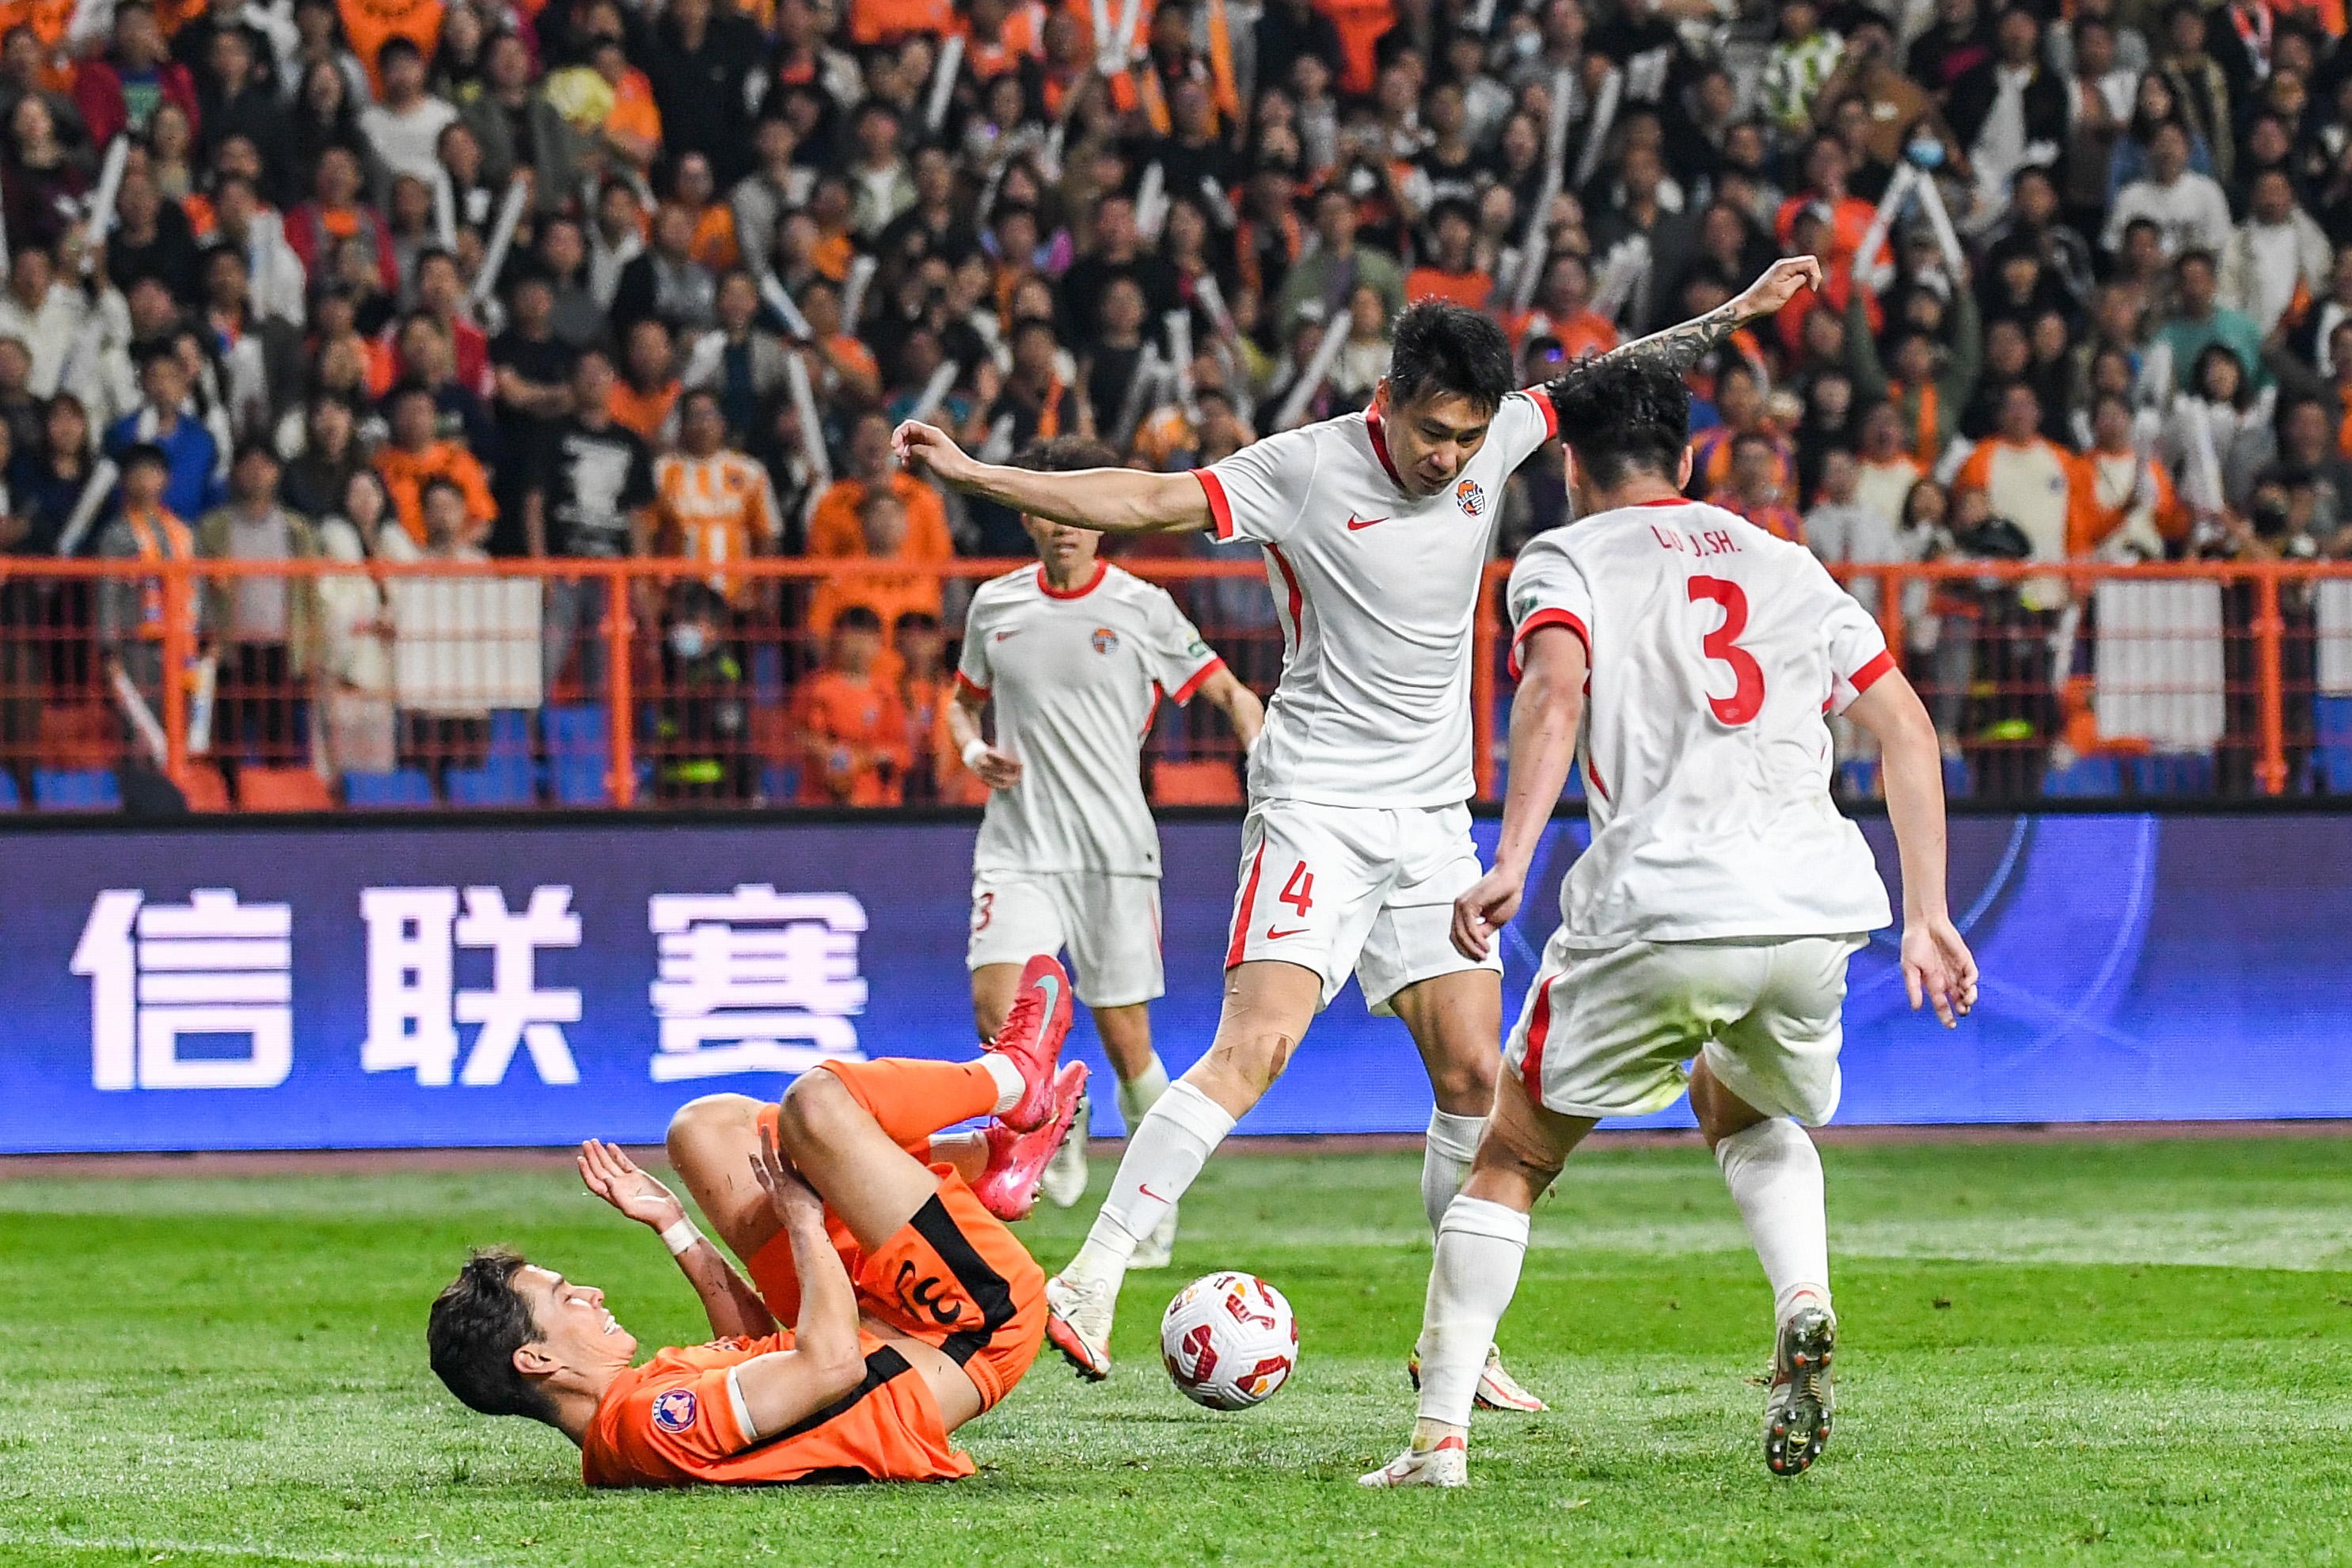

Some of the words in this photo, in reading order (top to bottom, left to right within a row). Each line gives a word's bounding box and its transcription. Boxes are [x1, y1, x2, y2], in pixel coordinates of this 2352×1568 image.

[1687, 575, 1765, 726] 3
[1279, 860, 1314, 917] 4
[71, 884, 868, 1091] 信联赛
